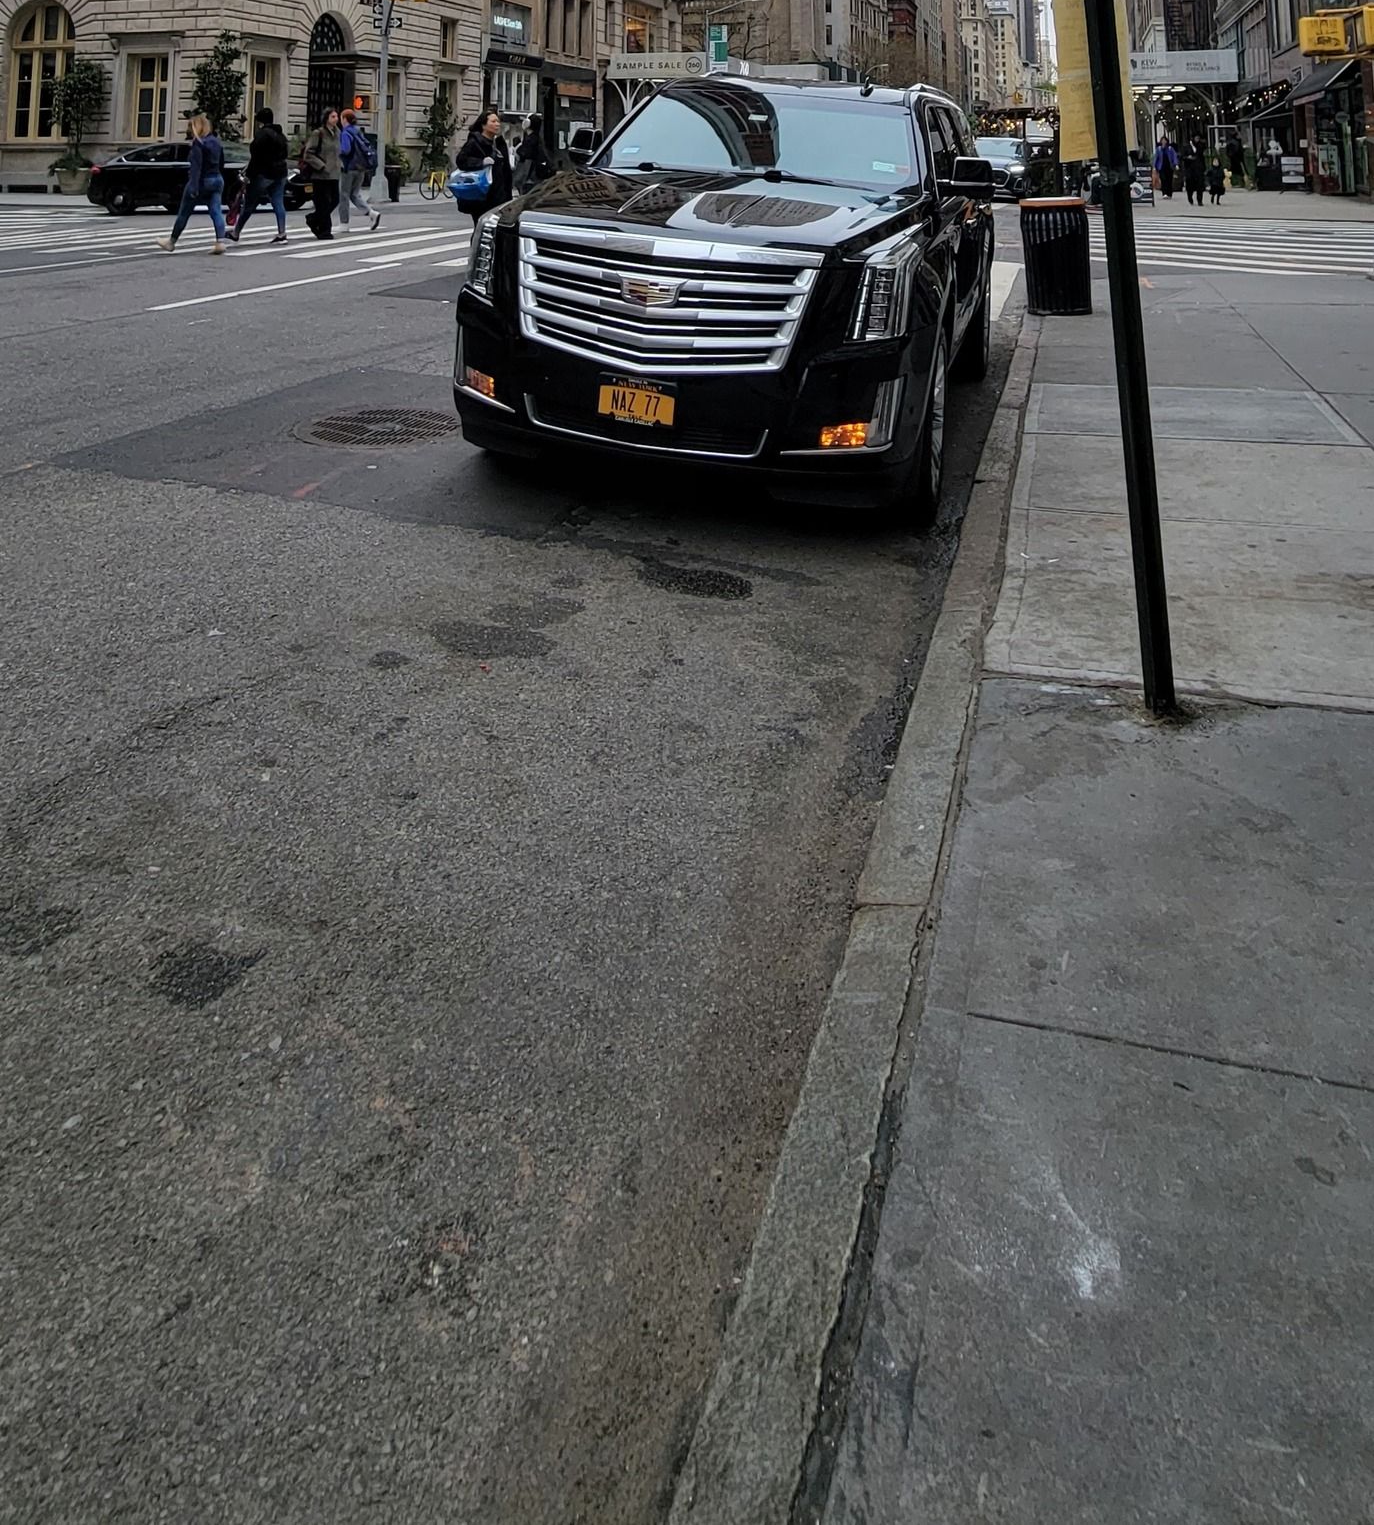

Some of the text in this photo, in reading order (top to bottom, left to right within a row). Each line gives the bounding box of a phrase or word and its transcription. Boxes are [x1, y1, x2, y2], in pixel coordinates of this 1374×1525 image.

[616, 62, 654, 70] SAMPLE
[658, 61, 681, 69] SALE
[611, 389, 660, 417] NAZ 77
